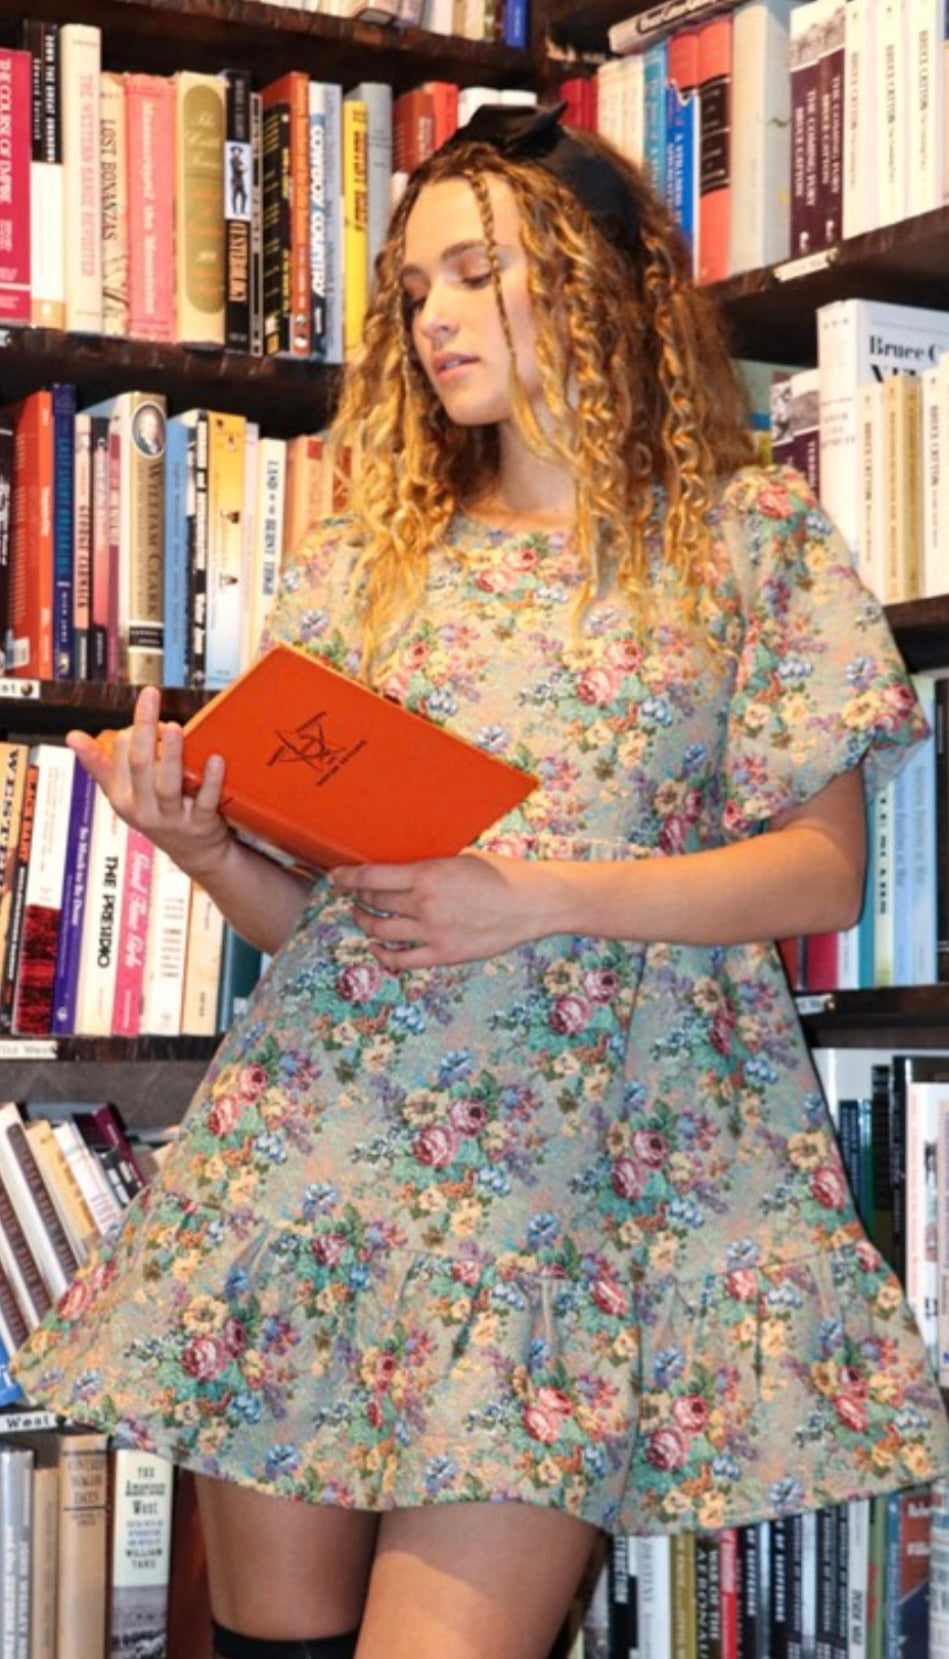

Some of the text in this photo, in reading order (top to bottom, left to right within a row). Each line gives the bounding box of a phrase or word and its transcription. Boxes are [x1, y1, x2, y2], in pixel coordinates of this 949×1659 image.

[806, 88, 817, 207] THE COMING FURY
[830, 75, 841, 193] THE COMING FURY
[101, 118, 119, 241] LOST BONANZAS
[311, 125, 326, 297] COWBOY COUNTRY
[868, 334, 925, 360] Bruce
[267, 460, 279, 490] LAND
[807, 440, 817, 494] TERRIBL
[78, 504, 88, 550] GEORGE
[146, 462, 164, 617] WILLIAM CLARK
[19, 767, 39, 859] BLACK BART
[77, 842, 89, 870] Much
[98, 855, 119, 969] THE PRESIDIO
[129, 850, 149, 891] Good
[7, 1415, 49, 1430] West
[132, 1500, 157, 1515] West
[137, 1467, 155, 1478] THE
[709, 1549, 720, 1640] WAR OF THE
[746, 1528, 757, 1617] OF SUFFERING
[775, 1533, 786, 1623] OF SUFFERING
